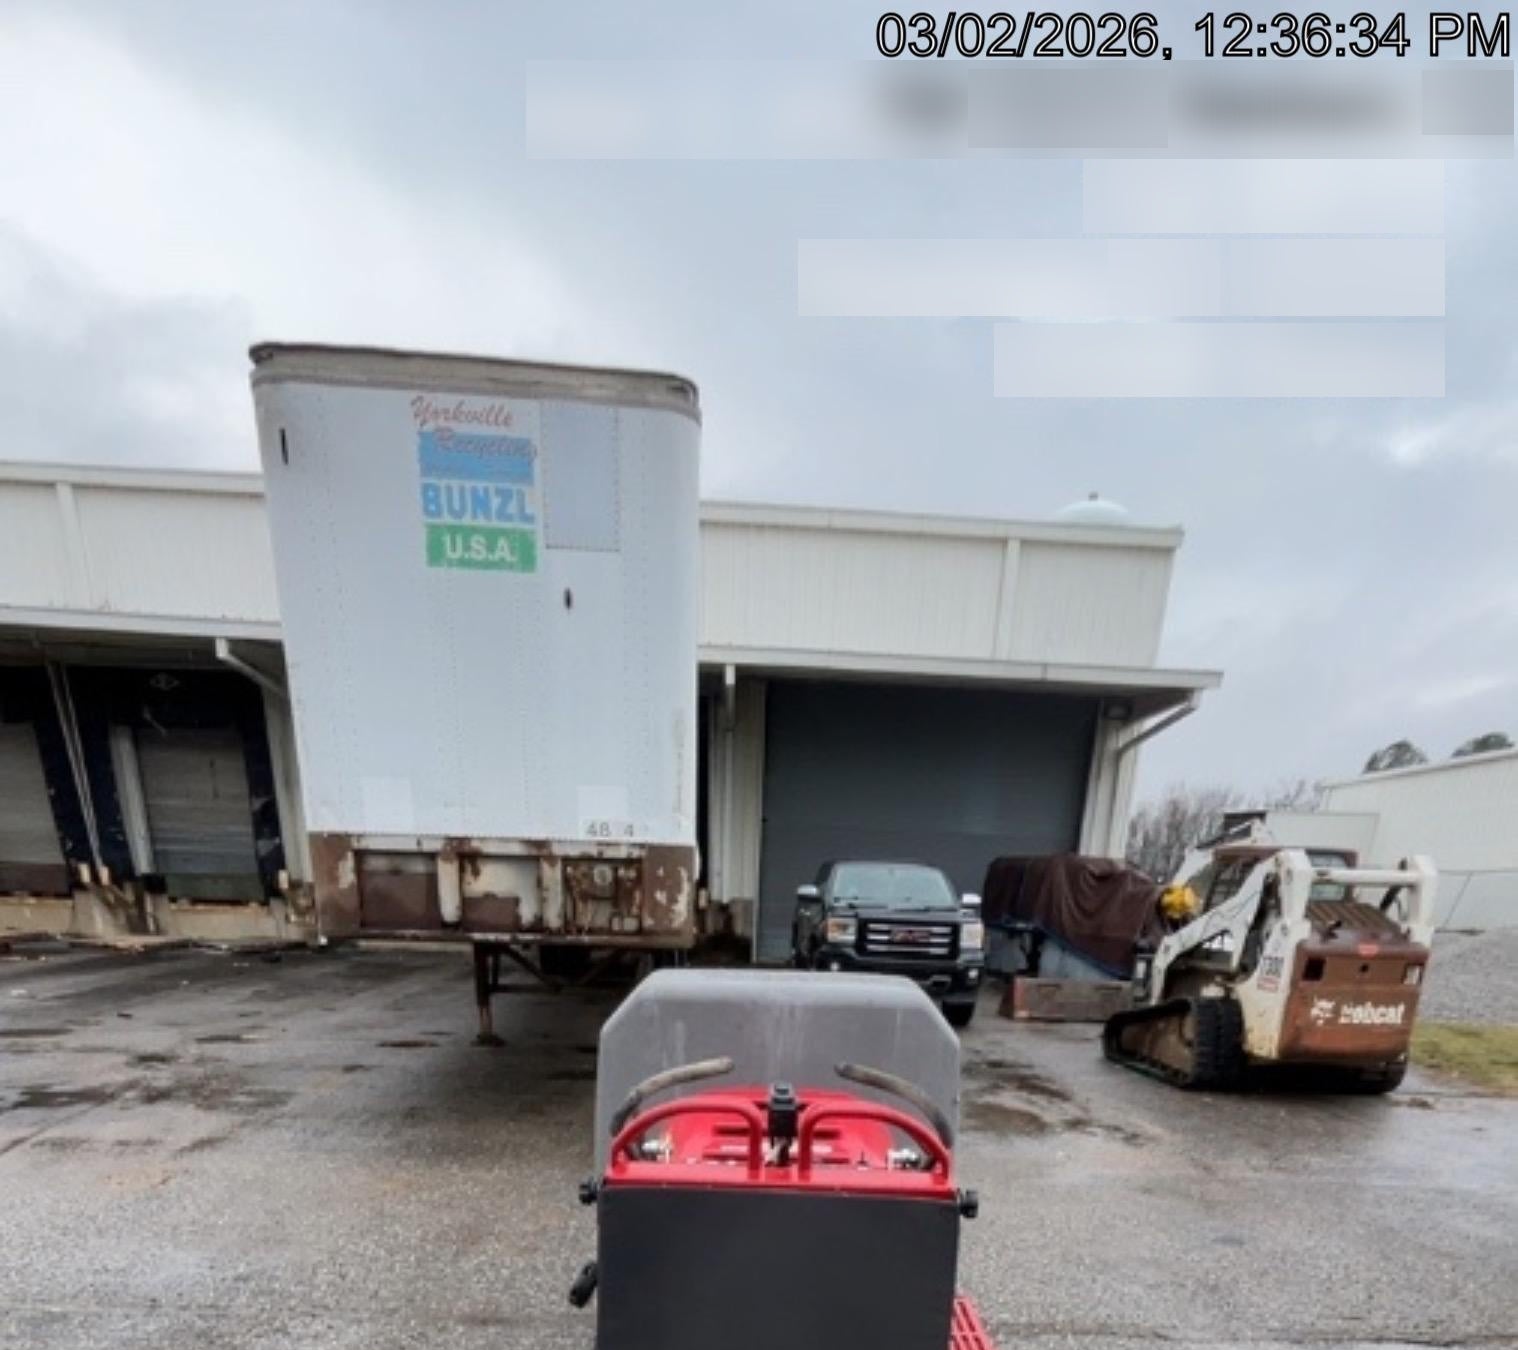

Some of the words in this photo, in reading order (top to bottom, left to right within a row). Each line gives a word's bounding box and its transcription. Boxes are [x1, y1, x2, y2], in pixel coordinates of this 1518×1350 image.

[411, 395, 514, 428] Yorkville
[421, 482, 536, 523] BUNZL
[443, 533, 519, 562] U.S.A.
